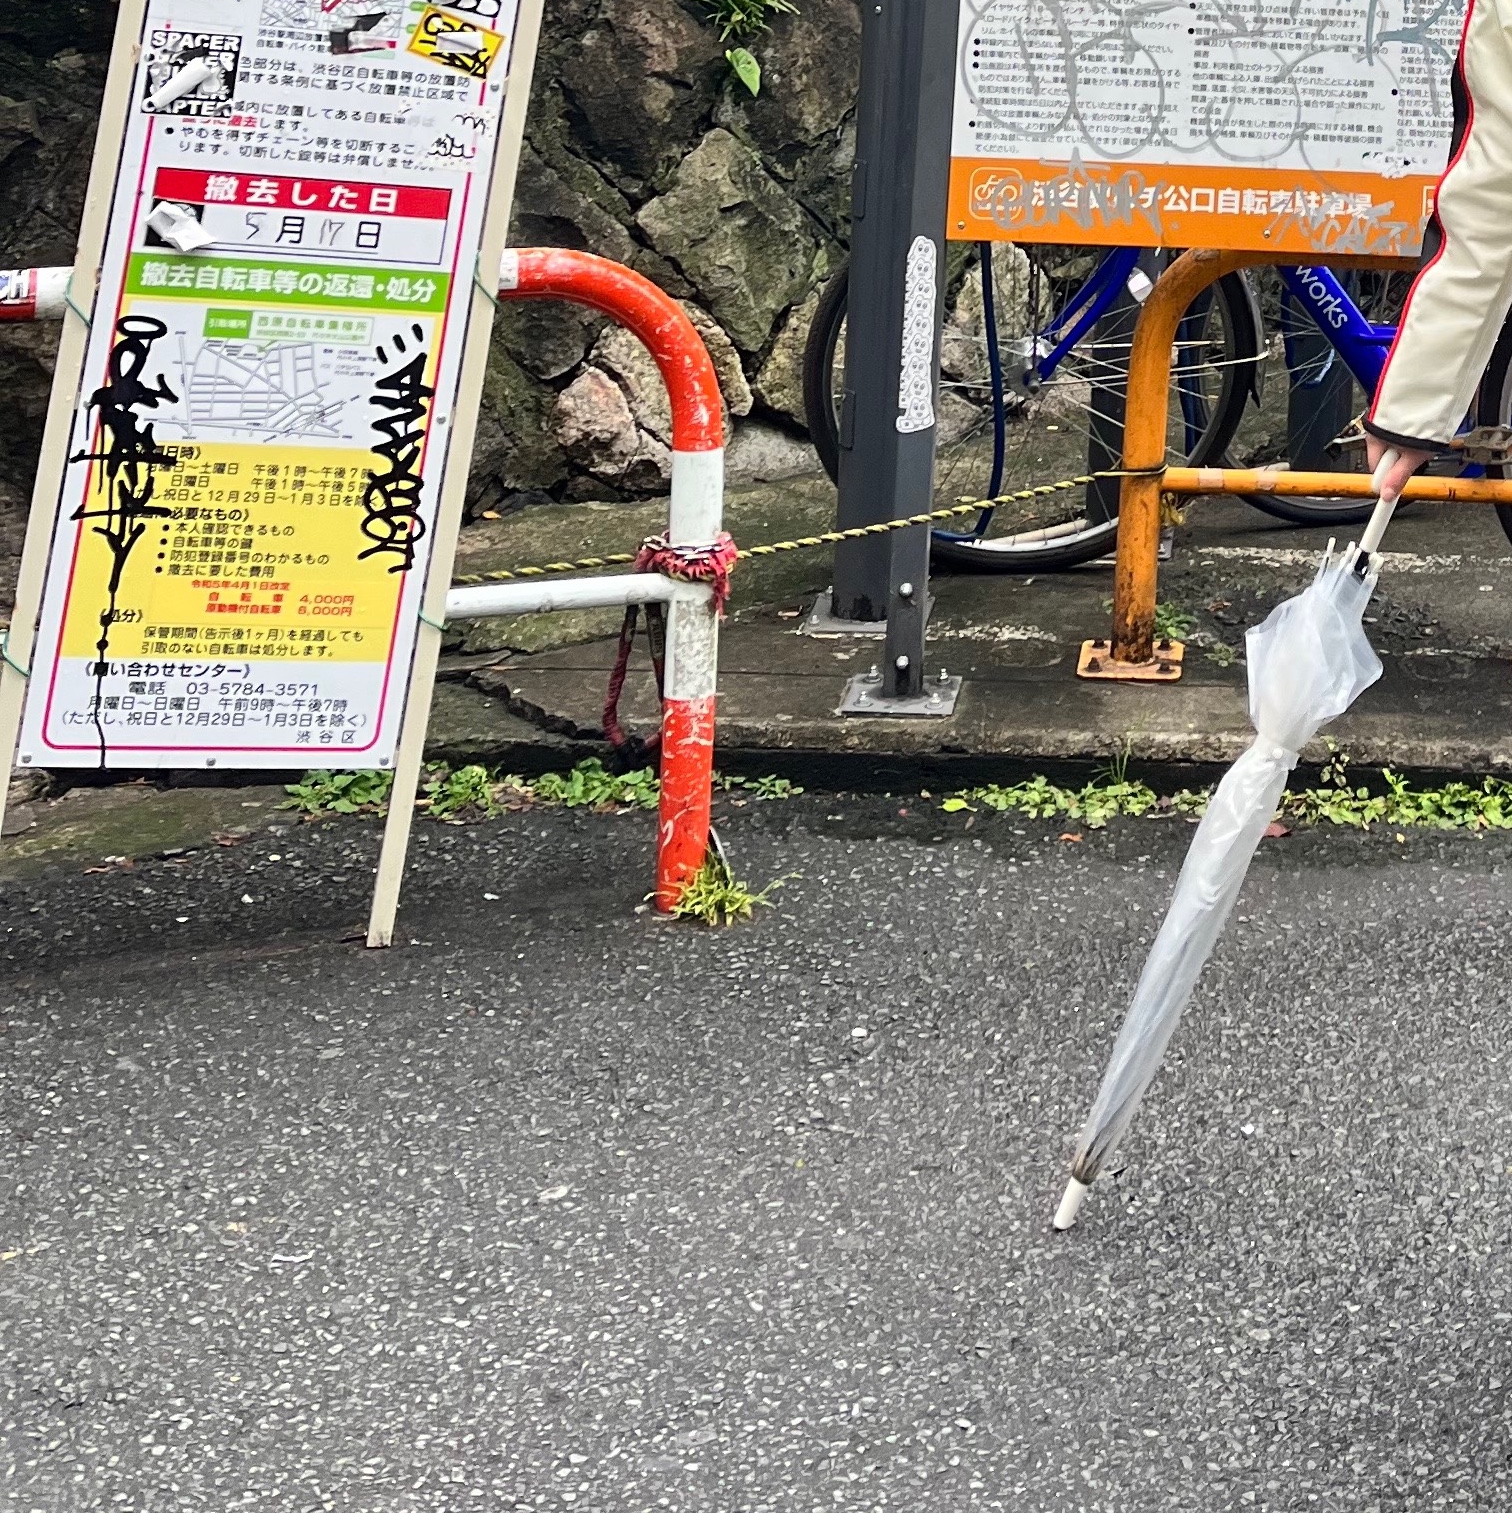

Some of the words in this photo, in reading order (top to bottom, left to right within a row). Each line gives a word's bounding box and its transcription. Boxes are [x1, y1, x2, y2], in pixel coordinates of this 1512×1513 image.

[204, 174, 399, 215] 撤去した日
[171, 475, 210, 488] 日曜日
[128, 681, 168, 696] 電話
[185, 681, 320, 697] 03-5784-3571
[295, 730, 356, 744] 渋谷区
